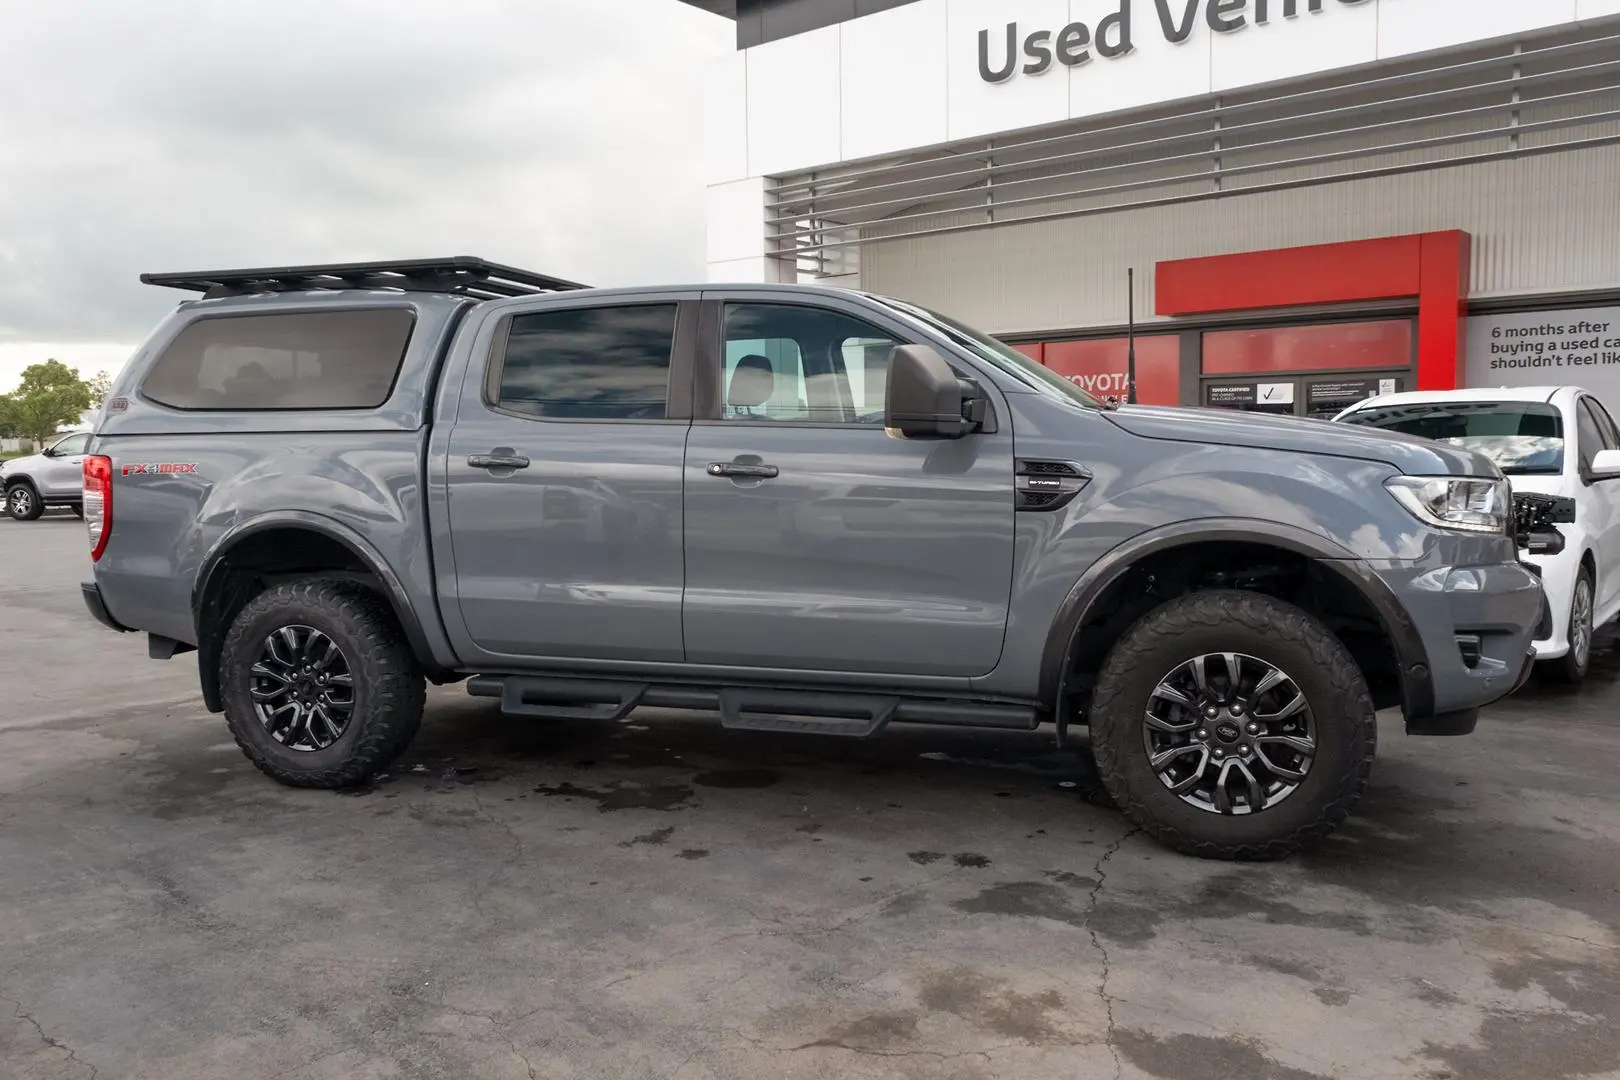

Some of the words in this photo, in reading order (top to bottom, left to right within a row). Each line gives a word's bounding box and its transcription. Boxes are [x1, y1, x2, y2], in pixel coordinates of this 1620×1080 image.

[978, 0, 1134, 84] Used
[1492, 327, 1501, 338] 6
[1505, 324, 1564, 337] months
[1568, 321, 1610, 334] after
[1491, 341, 1544, 355] buying
[1548, 342, 1557, 351] a
[1561, 337, 1599, 350] used
[1490, 355, 1563, 369] shouldn't
[1567, 353, 1597, 365] feel
